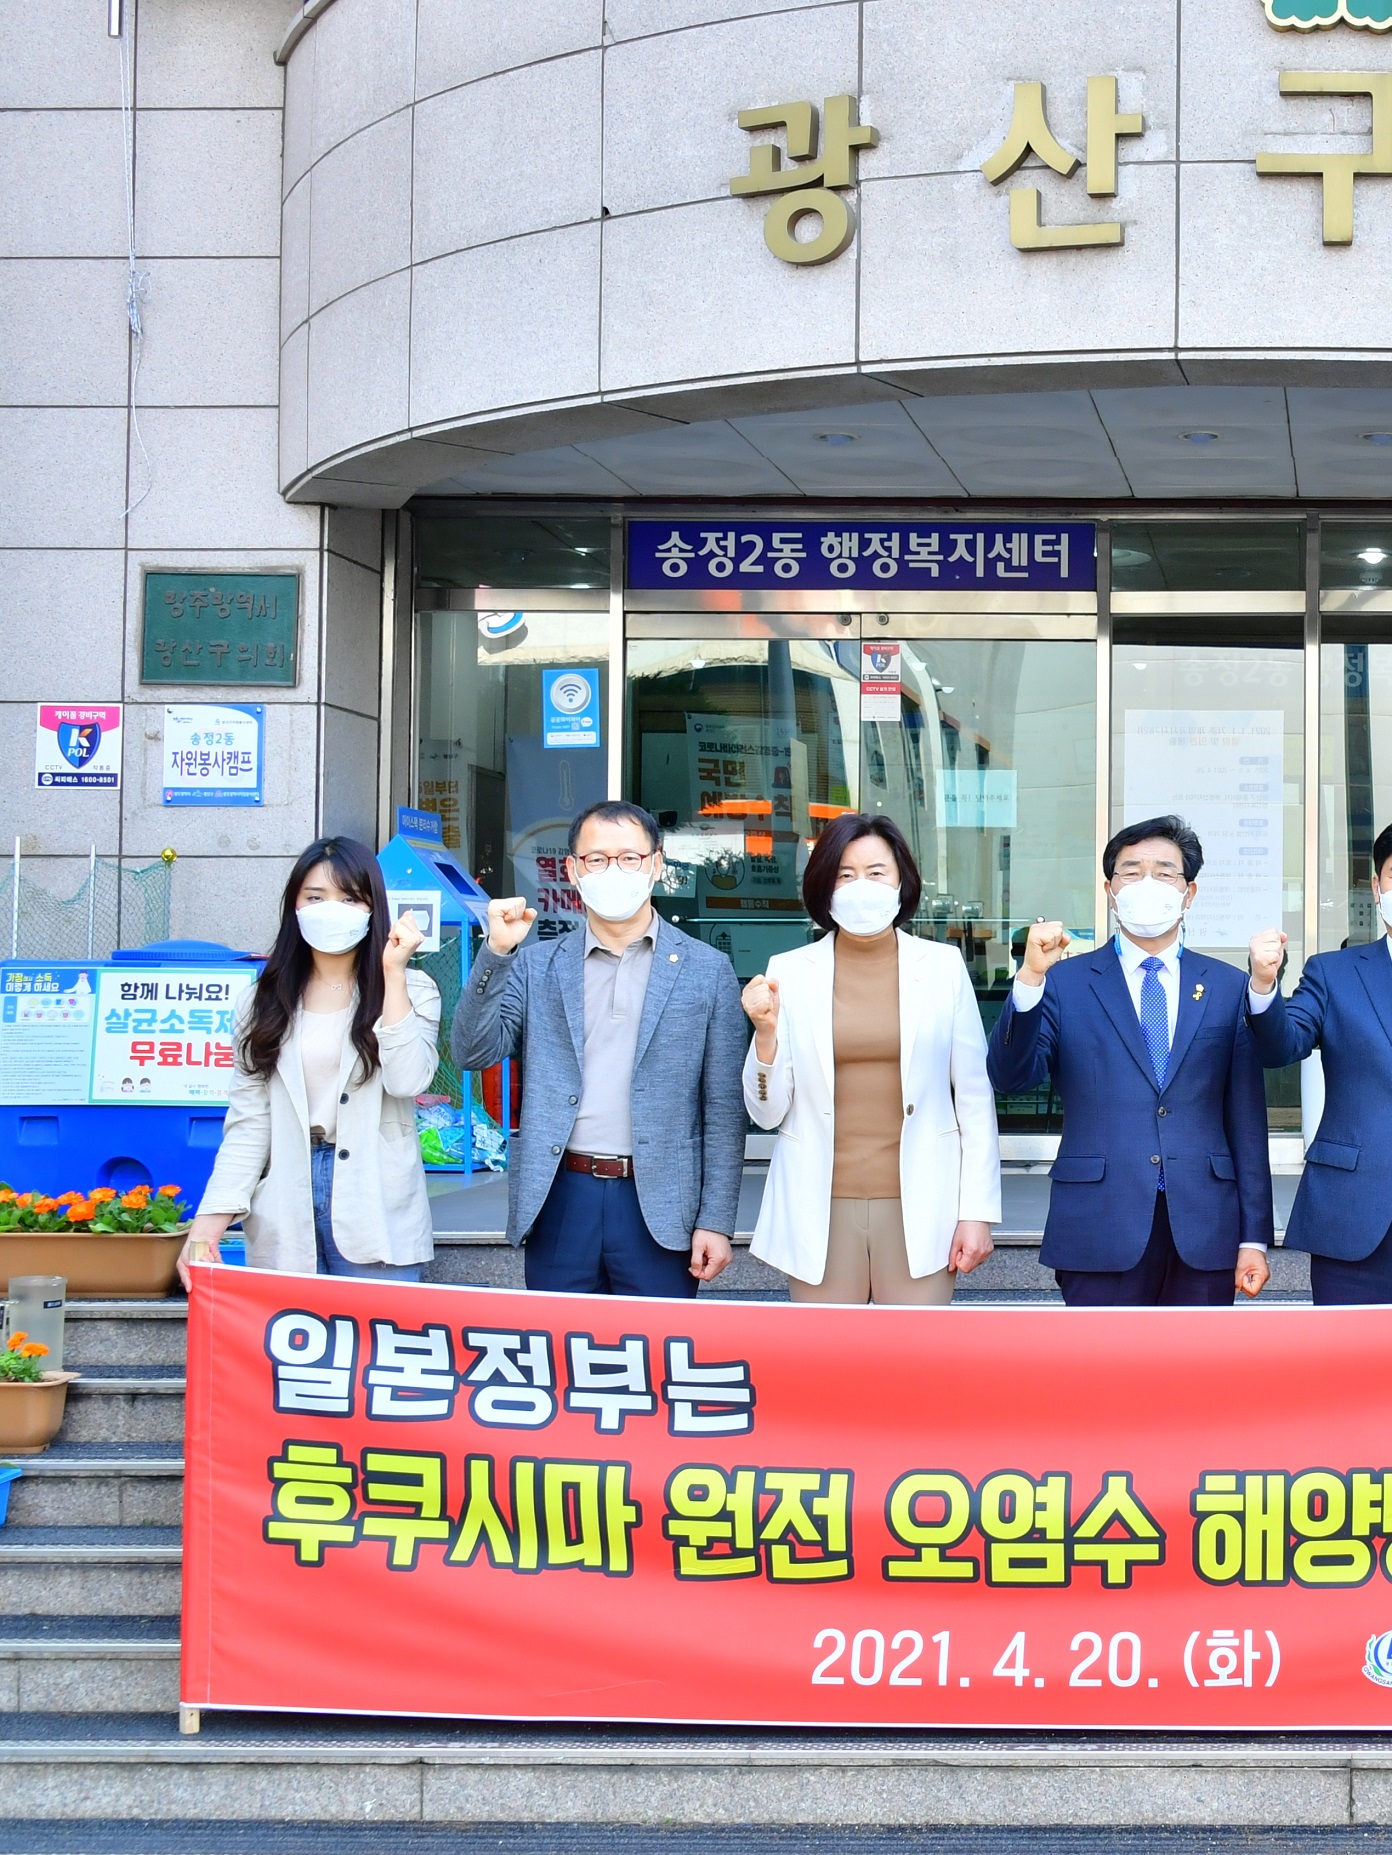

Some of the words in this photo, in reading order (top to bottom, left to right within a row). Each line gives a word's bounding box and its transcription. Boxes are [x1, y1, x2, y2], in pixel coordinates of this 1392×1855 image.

[654, 530, 807, 579] 송정2동
[821, 531, 1070, 581] 행정복지센터
[164, 590, 278, 620] 광주광역시
[155, 639, 285, 668] 광산구의회
[78, 710, 106, 720] 경비구역
[69, 728, 92, 748] K
[190, 732, 235, 746] 송정2동
[67, 748, 90, 758] POL
[171, 750, 253, 777] 자원봉사캠프
[698, 758, 747, 788] 국민
[120, 982, 158, 1001] 함께
[165, 983, 230, 1002] 나눠요!
[265, 1309, 756, 1437] 일본정부는
[263, 1440, 642, 1577] 후쿠시마
[661, 1463, 855, 1584] 원전
[882, 1469, 1168, 1588] 오염수
[811, 1627, 970, 1688] 2021.
[1000, 1630, 1046, 1689] 4.
[1069, 1630, 1159, 1689] 20.
[1183, 1628, 1283, 1690] (화)
